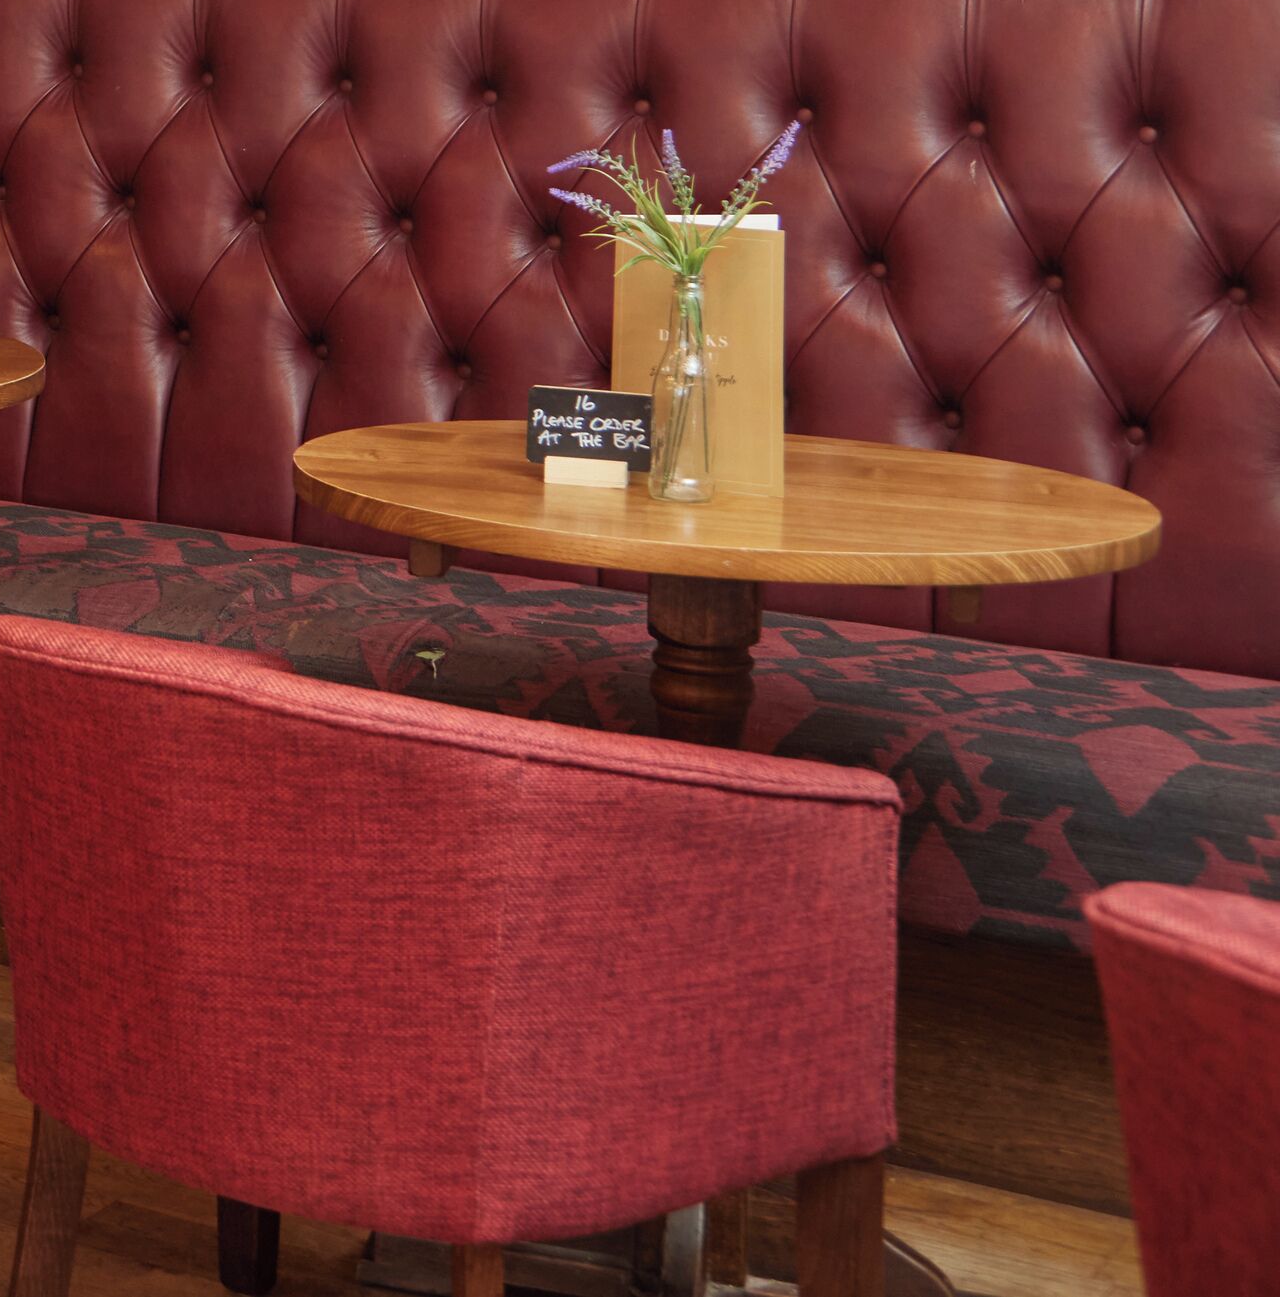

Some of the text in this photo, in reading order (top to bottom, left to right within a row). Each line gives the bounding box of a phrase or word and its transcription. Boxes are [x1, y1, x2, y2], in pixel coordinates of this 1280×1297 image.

[575, 395, 596, 411] 16
[532, 409, 646, 432] PLEASE ORDER
[537, 429, 651, 451] AT THE BAR
